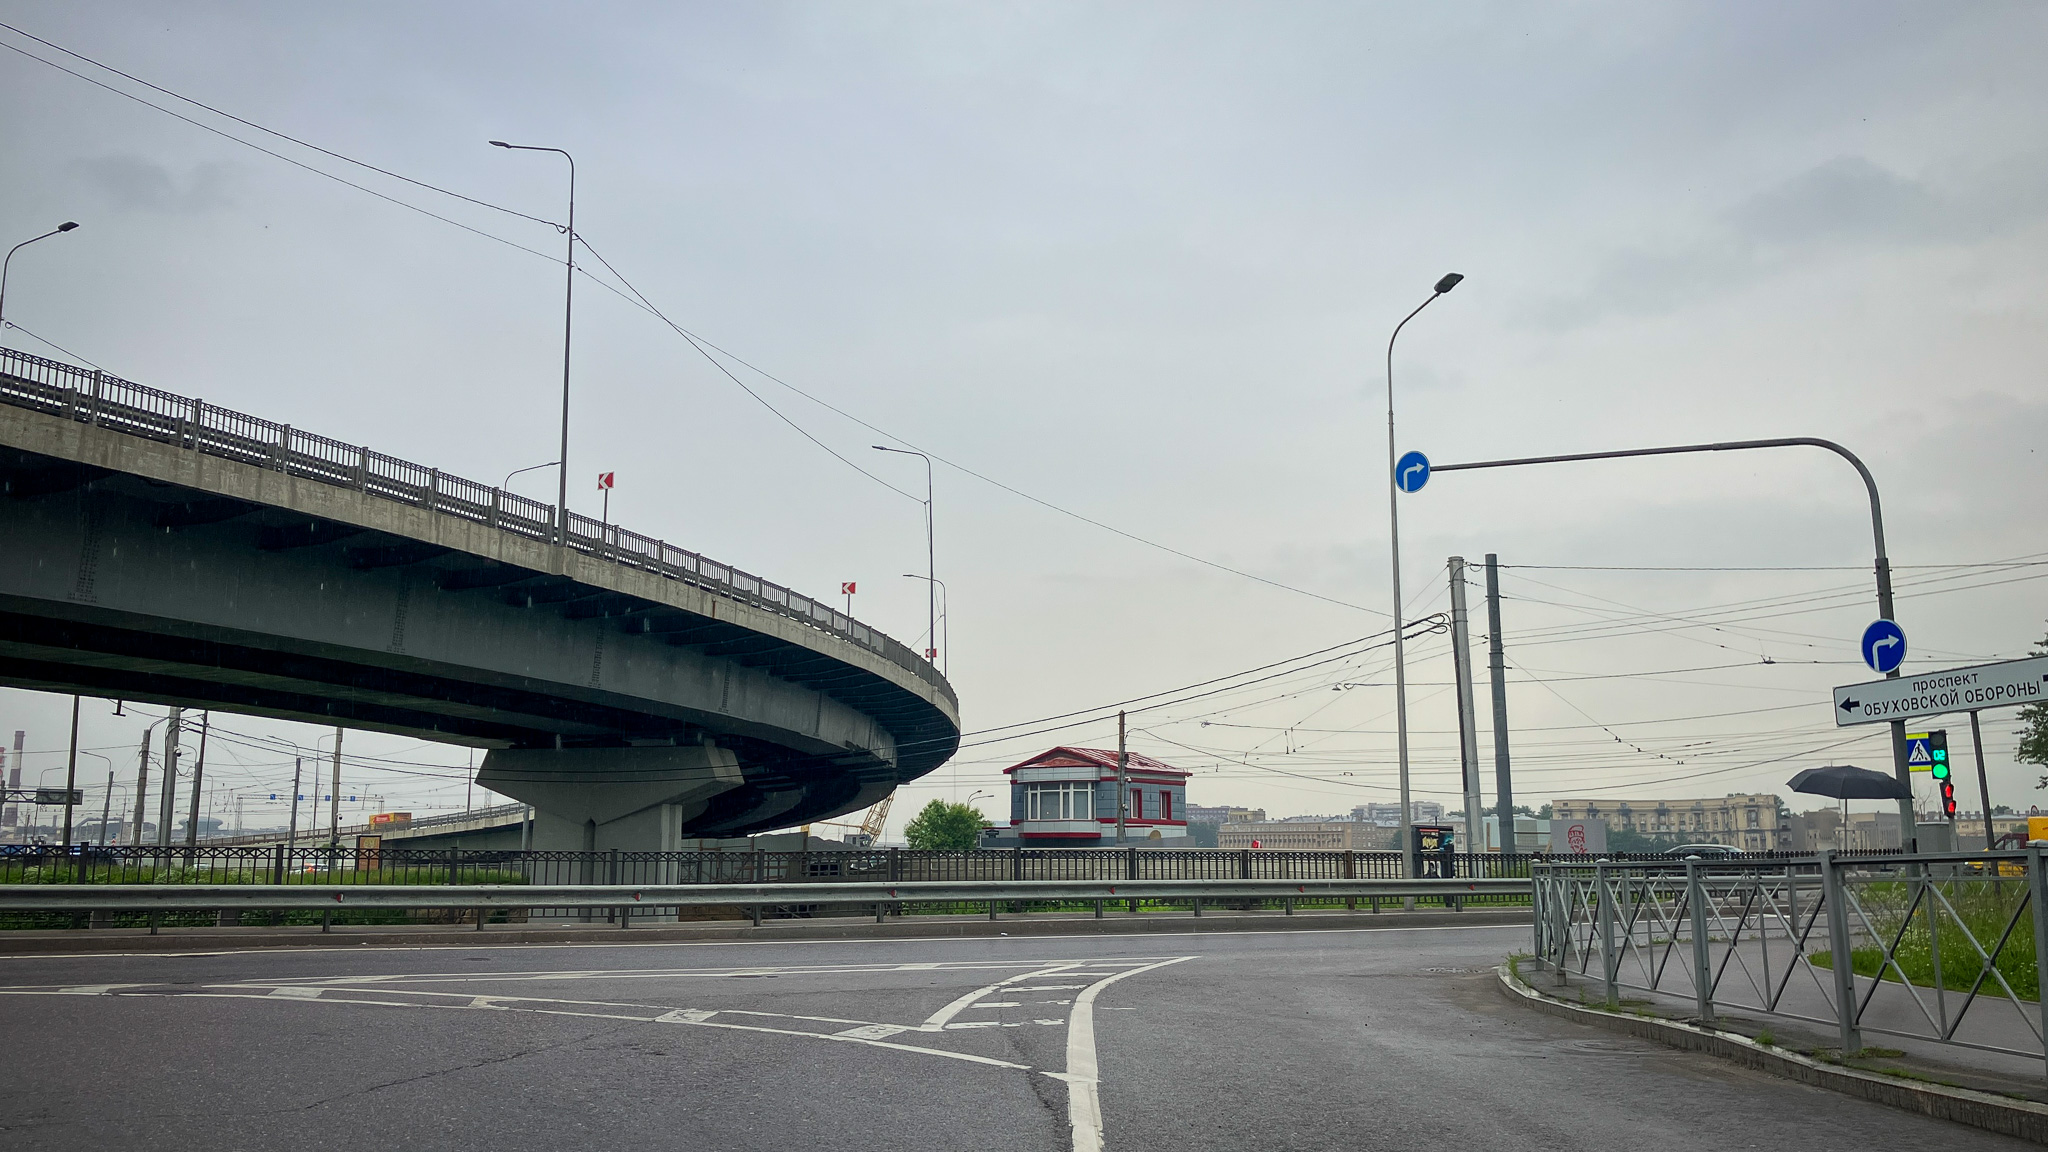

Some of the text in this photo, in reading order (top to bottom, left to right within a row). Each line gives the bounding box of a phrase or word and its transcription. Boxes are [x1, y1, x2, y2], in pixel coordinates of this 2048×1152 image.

[1913, 673, 1978, 694] проспект
[1864, 681, 2041, 716] ОБУХОВСКОЙ ОБОРОНЫ
[1933, 749, 1946, 761] 02
